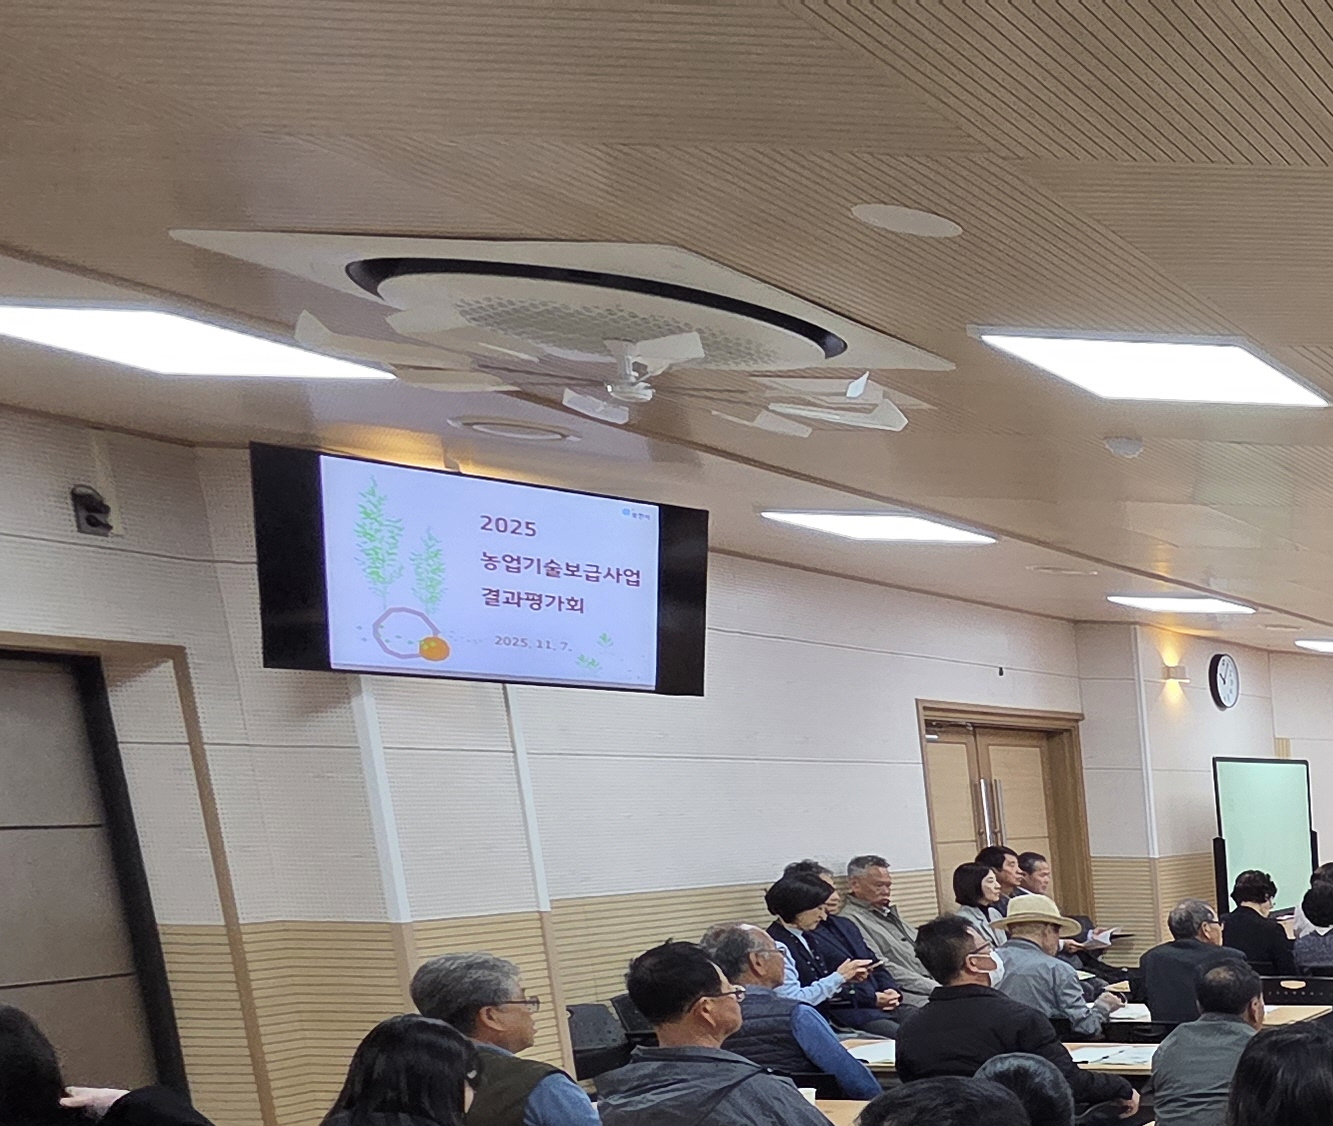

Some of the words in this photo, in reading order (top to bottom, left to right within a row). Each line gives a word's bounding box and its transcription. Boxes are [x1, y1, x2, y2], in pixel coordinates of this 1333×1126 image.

[479, 515, 537, 538] 2025
[480, 551, 641, 587] 농업기술보급사업
[481, 587, 584, 614] 결과평가회
[494, 635, 532, 649] 2025.
